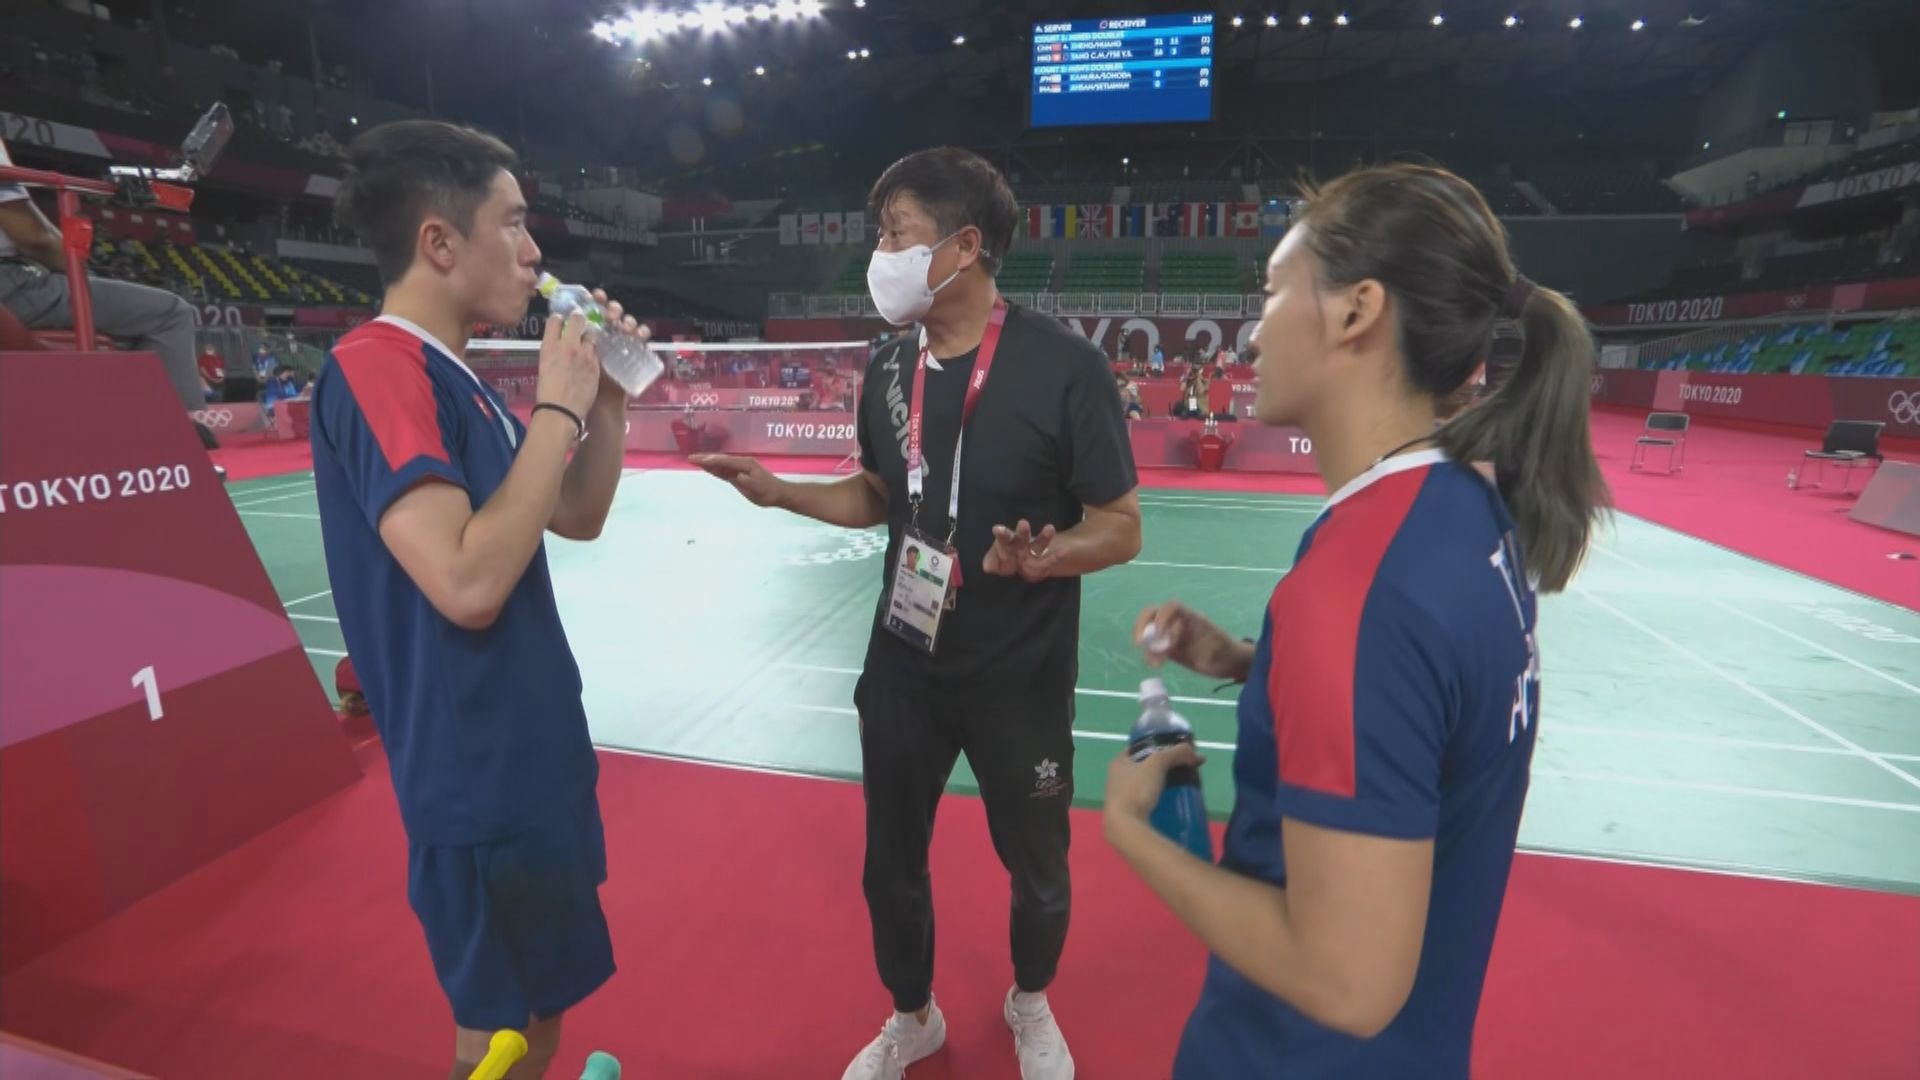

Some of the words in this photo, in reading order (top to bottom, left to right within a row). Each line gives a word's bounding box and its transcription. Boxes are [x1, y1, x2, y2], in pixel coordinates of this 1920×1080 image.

[1044, 24, 1072, 33] SERVER
[1108, 19, 1146, 29] RECEIVER
[1627, 301, 1676, 323] TOKYO
[1680, 297, 1724, 320] 2020
[749, 395, 780, 407] TOKYO
[1679, 383, 1710, 402] TOKYO
[1711, 386, 1742, 404] 2020
[766, 423, 815, 438] TOKYO
[816, 424, 855, 440] 2020
[117, 464, 190, 497] 2020
[130, 666, 164, 721] 1
